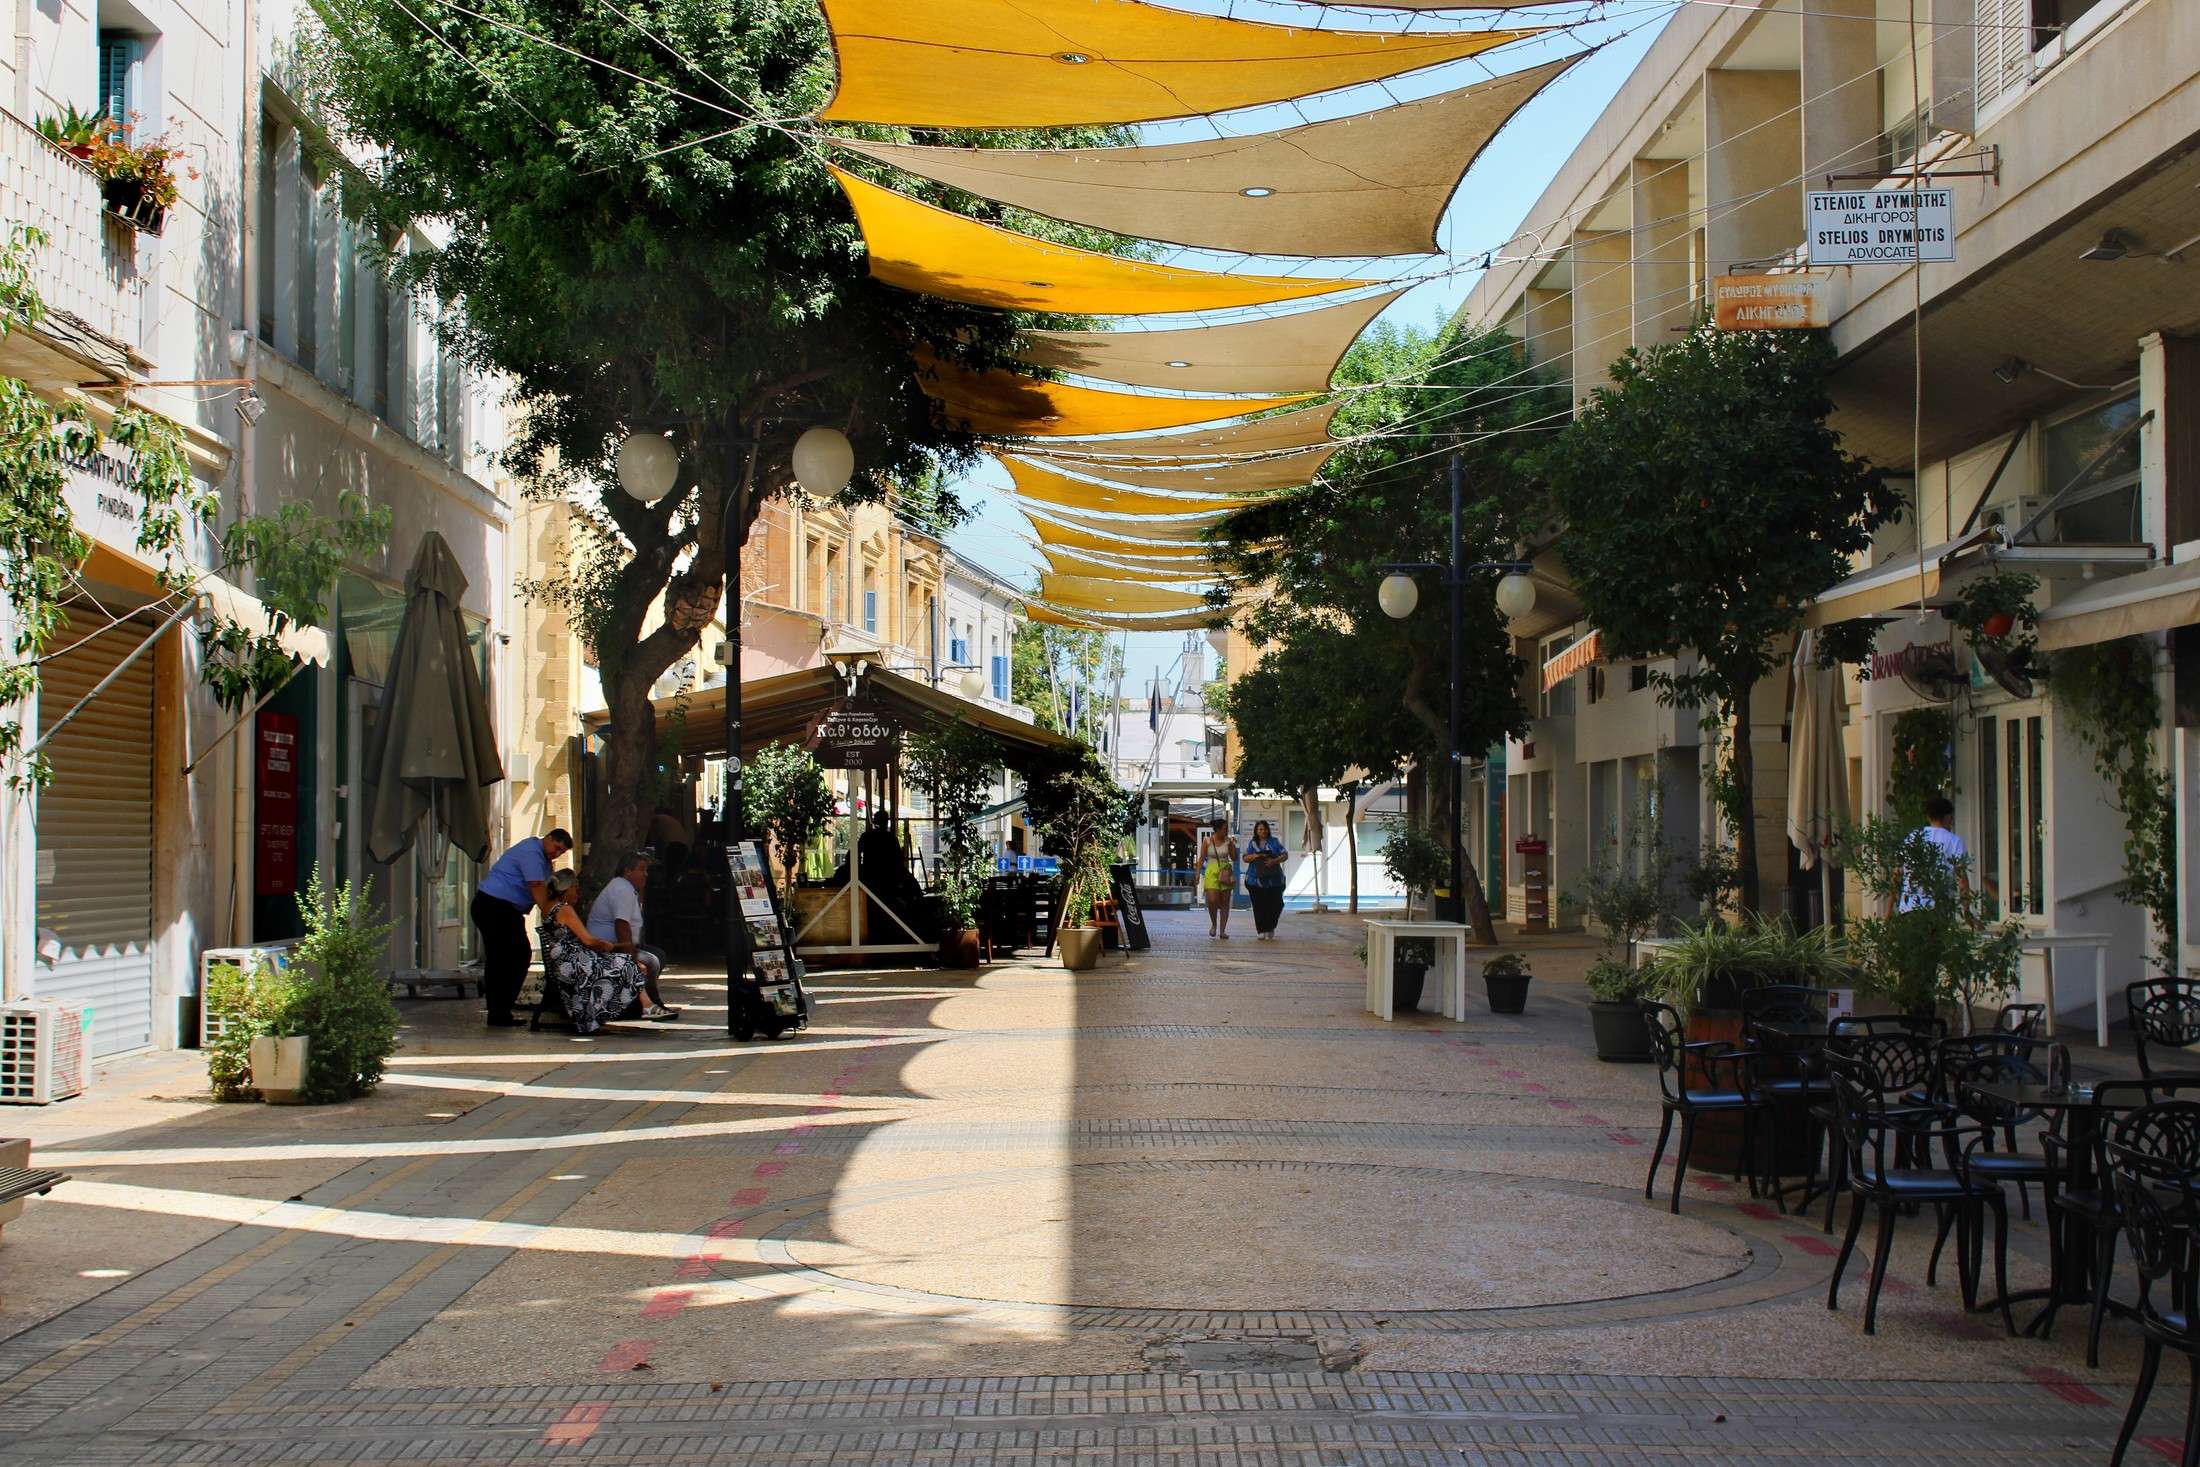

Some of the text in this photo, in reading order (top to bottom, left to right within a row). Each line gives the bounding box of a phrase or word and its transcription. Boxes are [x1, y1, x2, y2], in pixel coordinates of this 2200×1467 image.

[1814, 193, 1947, 211] ΣΤΕΛΙΟΣ ΔΡΥΜΙΩΤΗΣ
[1844, 211, 1916, 225] ΔΙΚΗΓΟΡΟΣ
[1818, 230, 1869, 245] STELIOS
[1848, 246, 1917, 259] ADVOCATE
[844, 758, 863, 766] 2000
